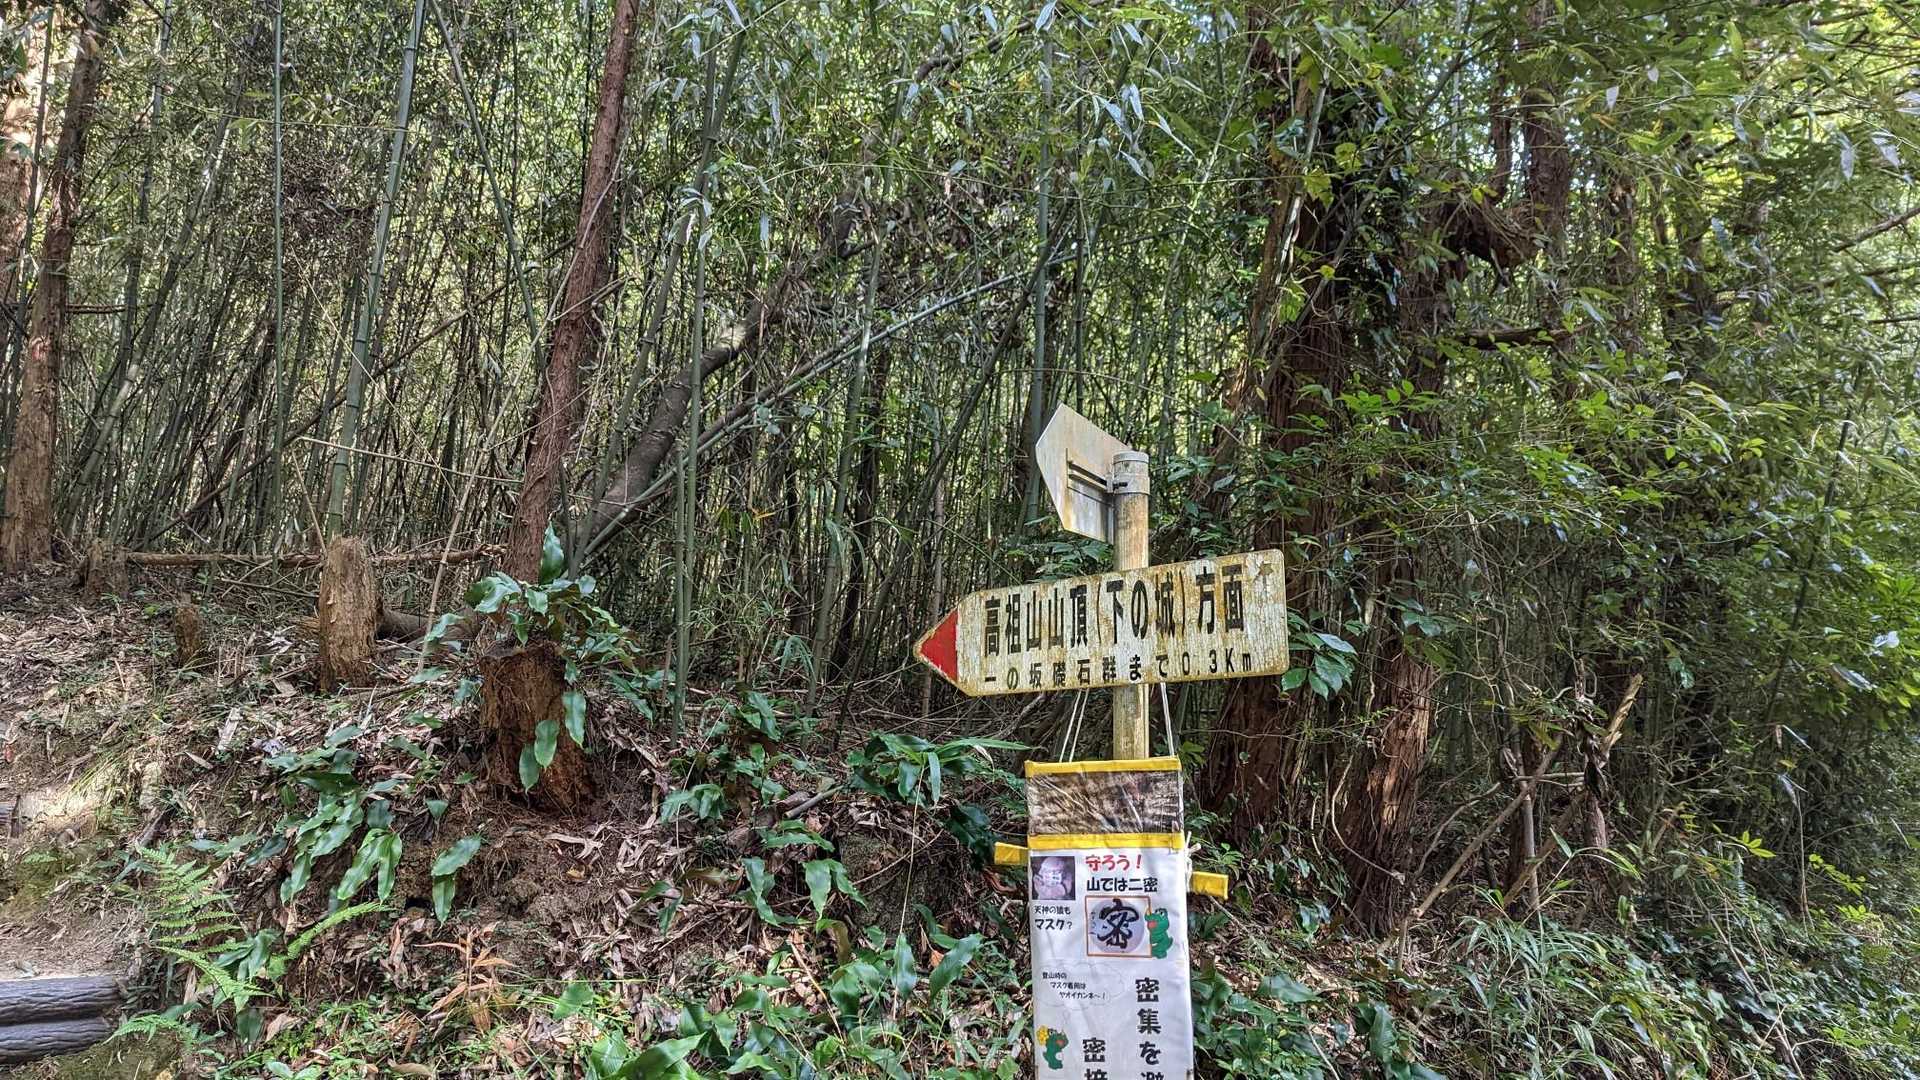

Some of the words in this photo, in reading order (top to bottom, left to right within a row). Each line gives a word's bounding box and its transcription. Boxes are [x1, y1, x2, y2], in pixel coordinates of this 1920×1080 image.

[1086, 855, 1142, 871] 守ろう！
[1087, 877, 1158, 893] 山では二密
[1034, 918, 1073, 930] マスク？
